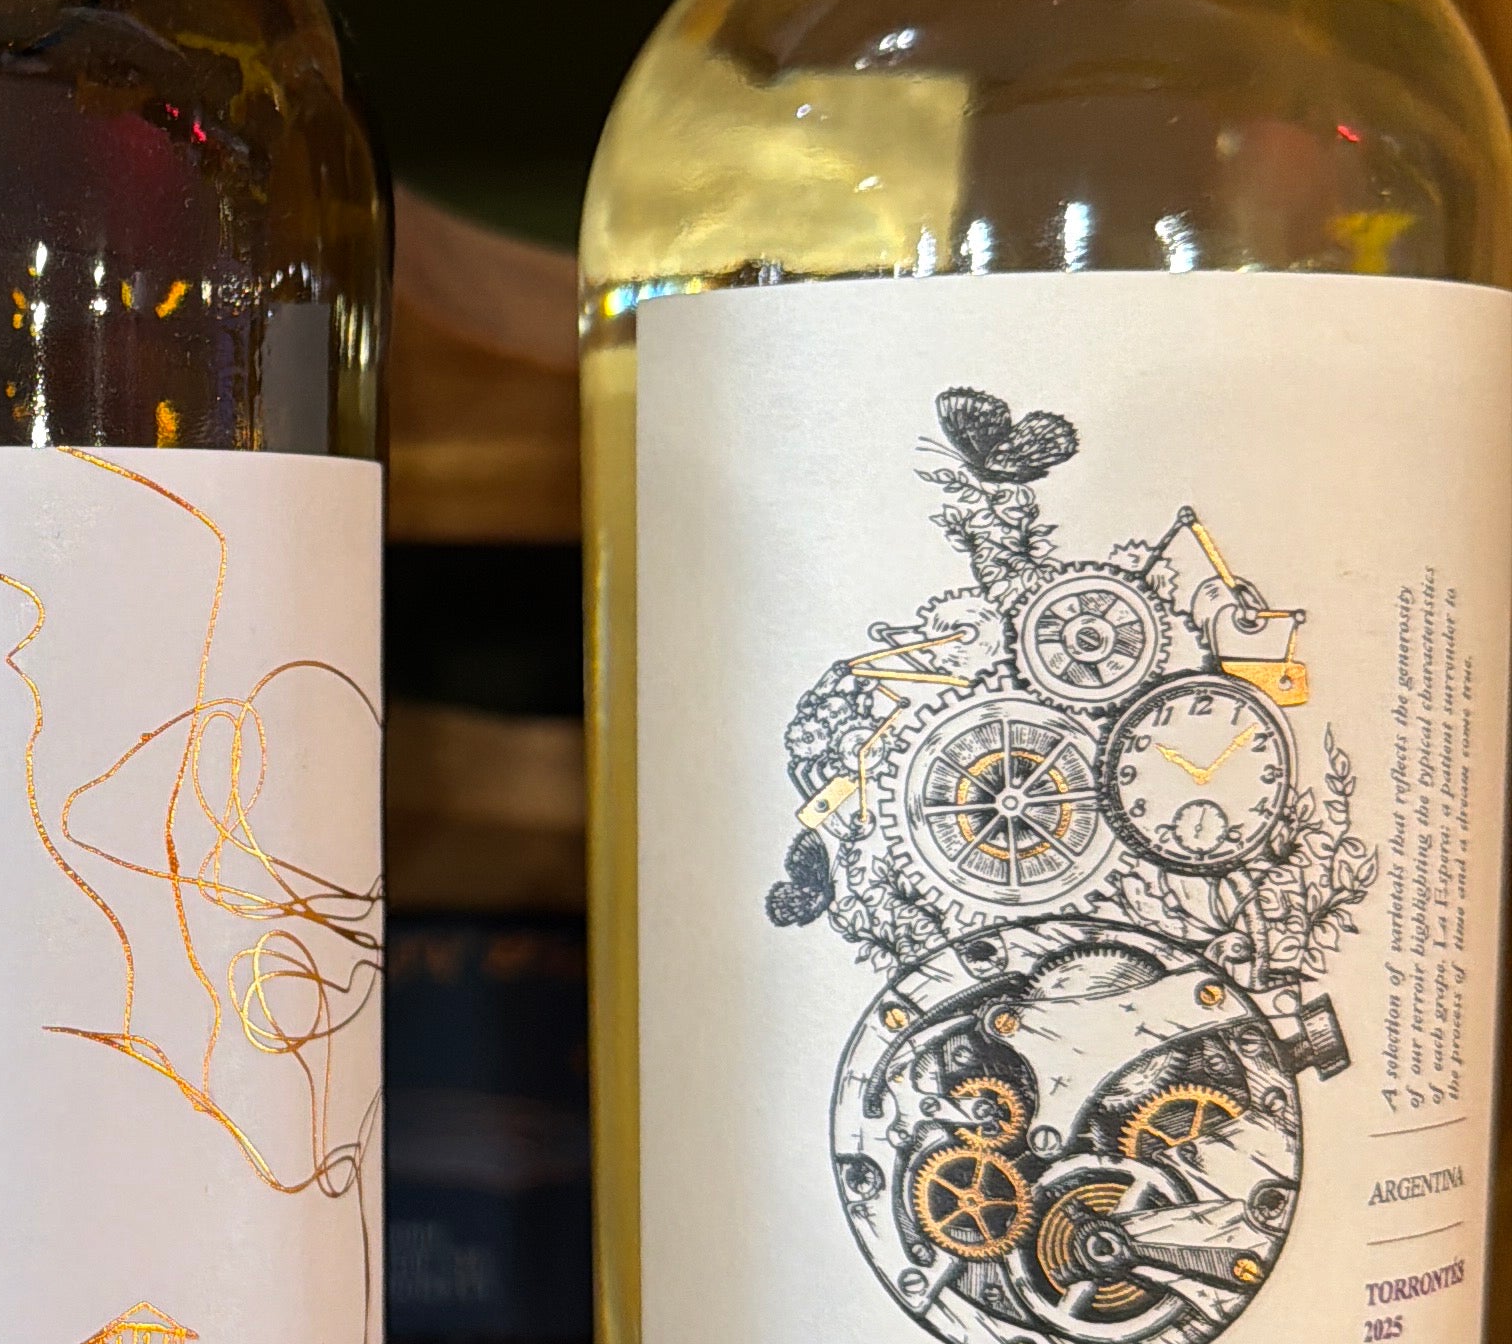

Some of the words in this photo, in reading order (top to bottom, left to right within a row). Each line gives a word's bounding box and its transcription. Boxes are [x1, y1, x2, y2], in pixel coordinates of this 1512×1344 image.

[1444, 588, 1457, 609] to
[1394, 586, 1415, 691] generosity
[1417, 565, 1435, 712] characteristics
[1441, 613, 1456, 715] surrender
[1152, 705, 1174, 727] 11
[1188, 695, 1214, 716] 12
[1391, 695, 1408, 727] the
[1251, 732, 1269, 752] 2
[1415, 716, 1435, 788] typical
[1461, 708, 1472, 758] come
[1119, 764, 1138, 786] 9
[1390, 734, 1410, 805] reflects
[1439, 721, 1454, 799] patient
[1129, 797, 1147, 818] 8
[1414, 795, 1430, 827] the
[1440, 803, 1451, 818] a
[1456, 765, 1470, 831] dream
[1388, 812, 1406, 857] that
[1459, 839, 1468, 853] a
[1410, 834, 1432, 957] highlighting
[1454, 858, 1467, 900] and
[1386, 863, 1405, 953] varietals
[1432, 916, 1447, 949] La
[1452, 906, 1466, 952] time
[1384, 962, 1405, 987] of
[1433, 959, 1449, 1023] grape.
[1451, 961, 1466, 985] of
[1409, 963, 1425, 1033] terroir
[1382, 994, 1401, 1079] selection
[1450, 992, 1463, 1065] process
[1410, 1038, 1424, 1075] our
[1430, 1027, 1444, 1072] each
[1380, 1089, 1398, 1113] A
[1405, 1085, 1425, 1109] of
[1428, 1083, 1444, 1105] of
[1447, 1070, 1459, 1101] the
[1368, 1165, 1465, 1206] ARGENTINA
[1365, 1257, 1465, 1307] TORRONTÉS
[1363, 1314, 1403, 1343] 2025
